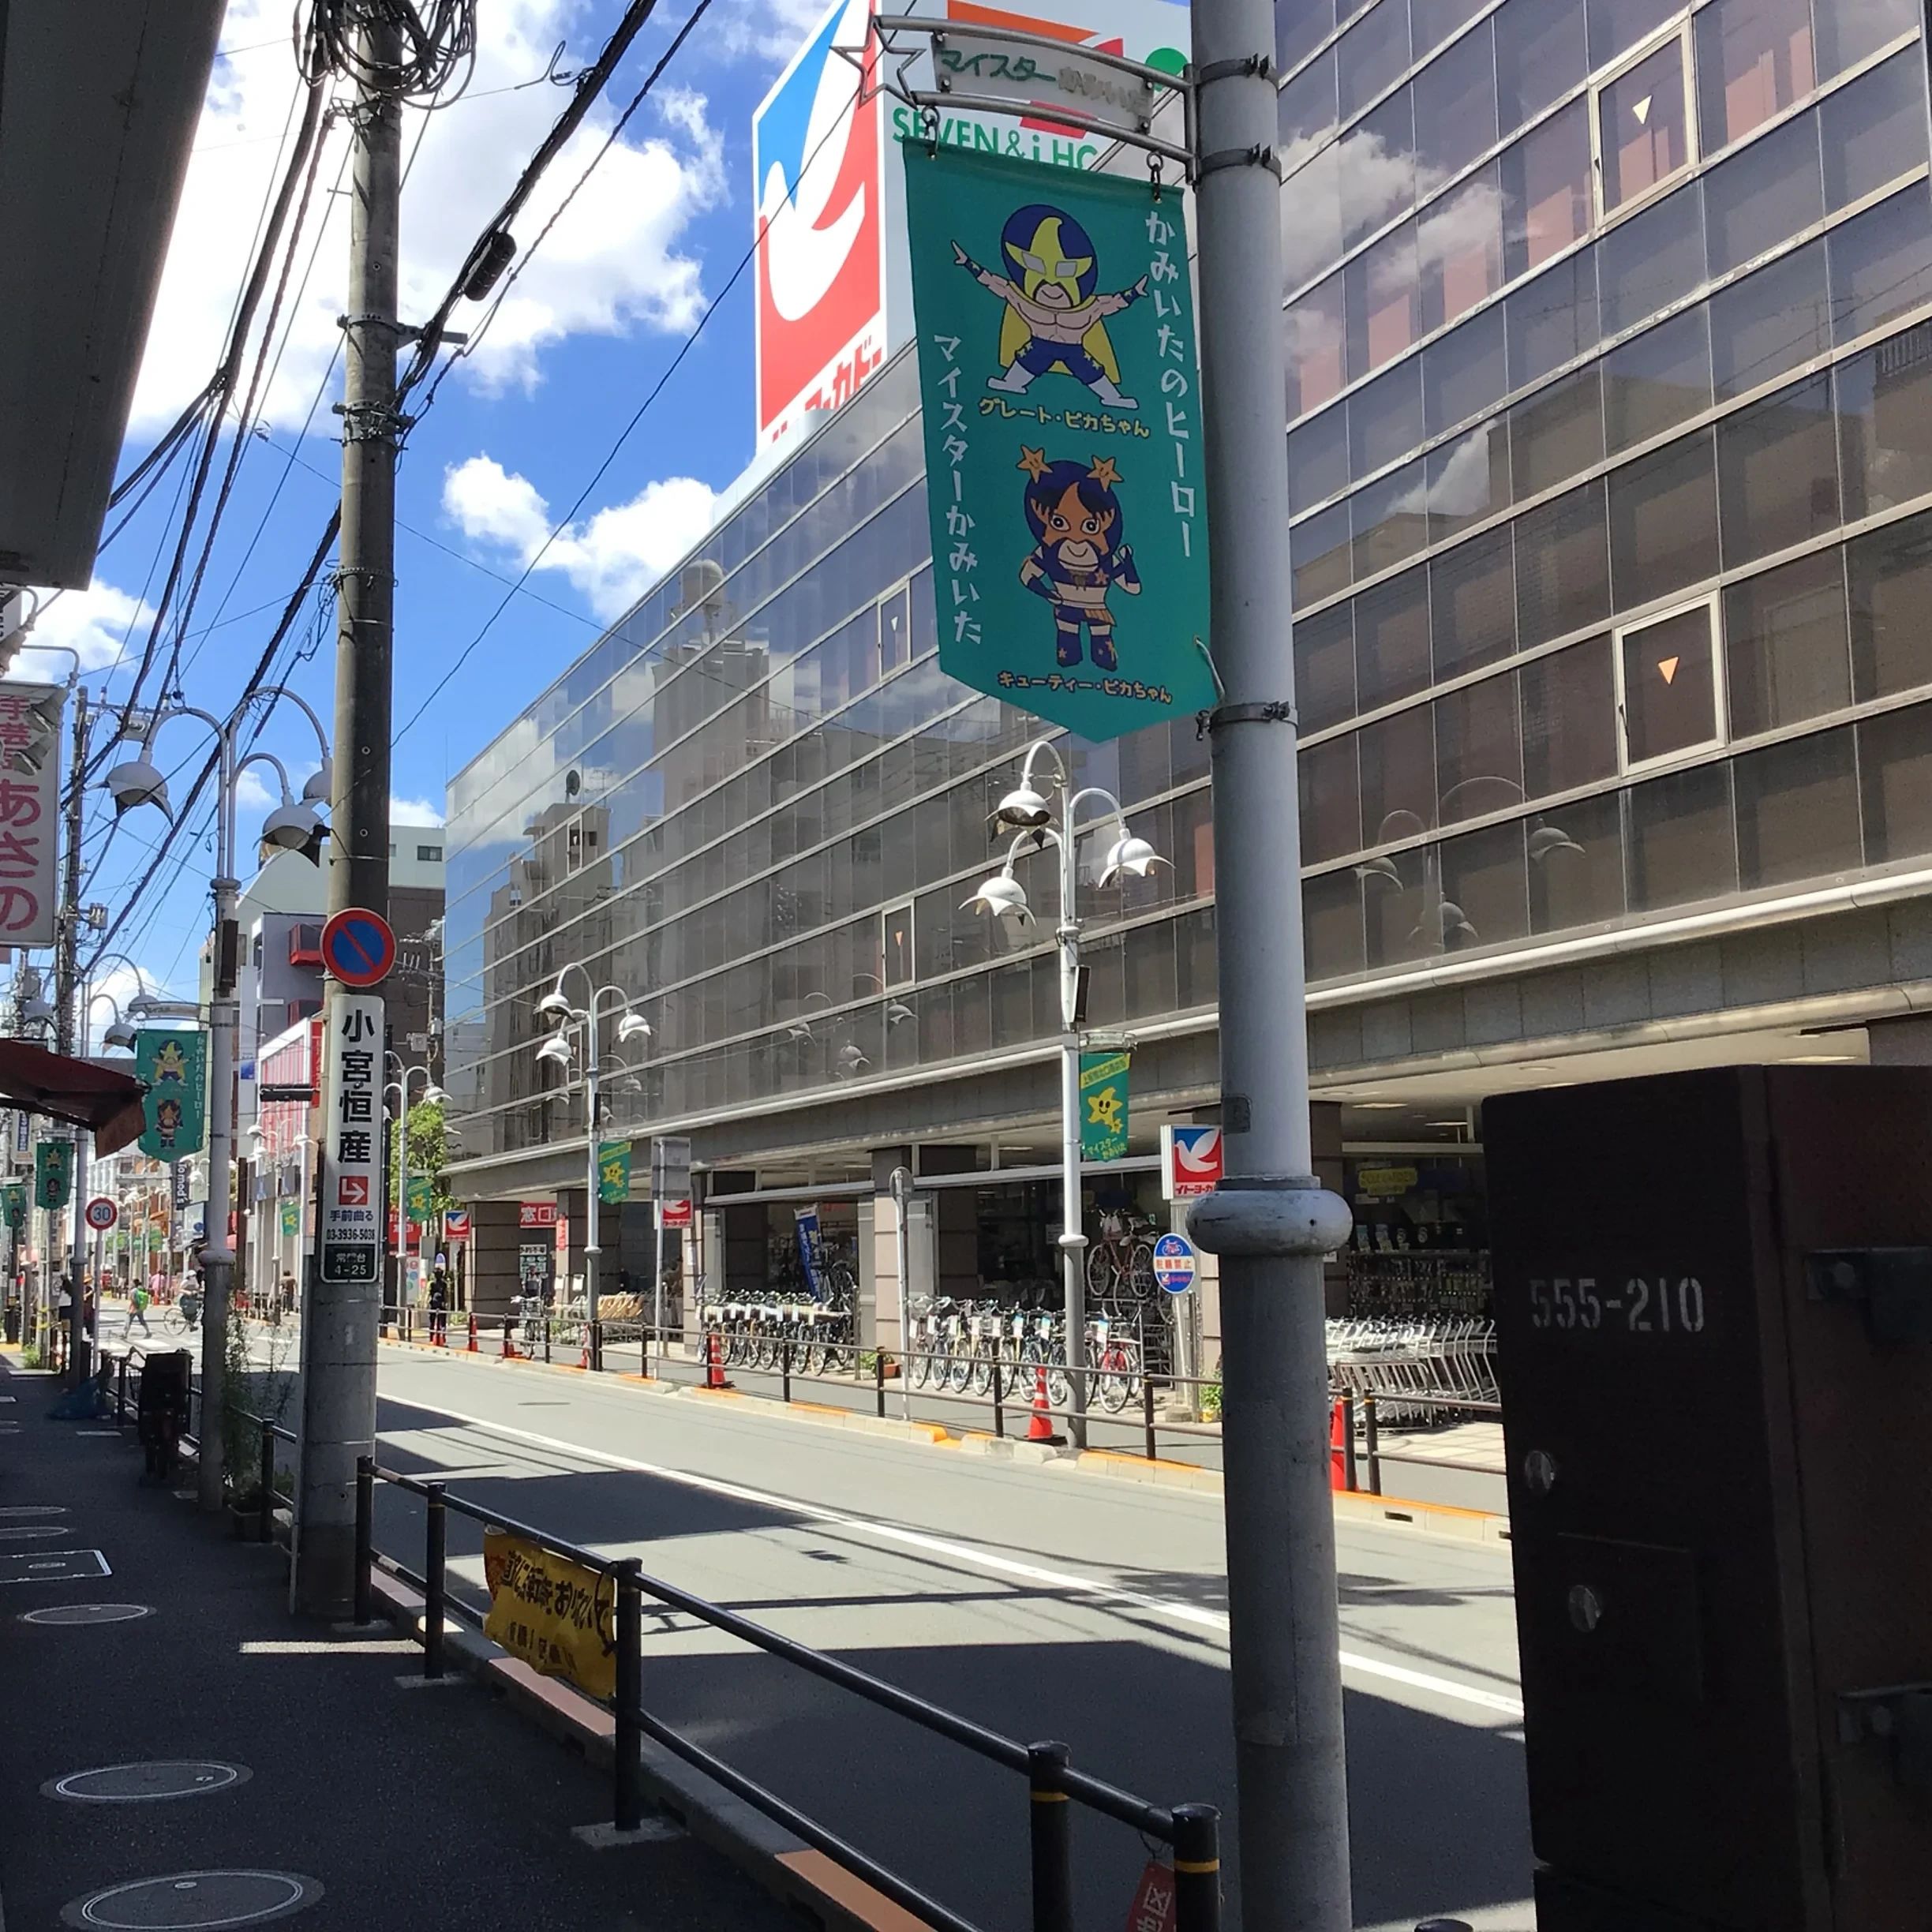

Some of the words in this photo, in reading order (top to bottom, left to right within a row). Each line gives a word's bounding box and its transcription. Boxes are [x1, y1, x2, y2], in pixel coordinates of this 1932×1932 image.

[1145, 211, 1196, 557] かみいたのヒーロー
[934, 333, 982, 645] マイスターかみいた
[337, 1009, 375, 1163] 小宮恒産
[92, 1207, 110, 1221] 30
[329, 1210, 373, 1222] 手前曲る
[334, 1264, 367, 1276] 4-25
[1530, 1278, 1705, 1332] 555-210
